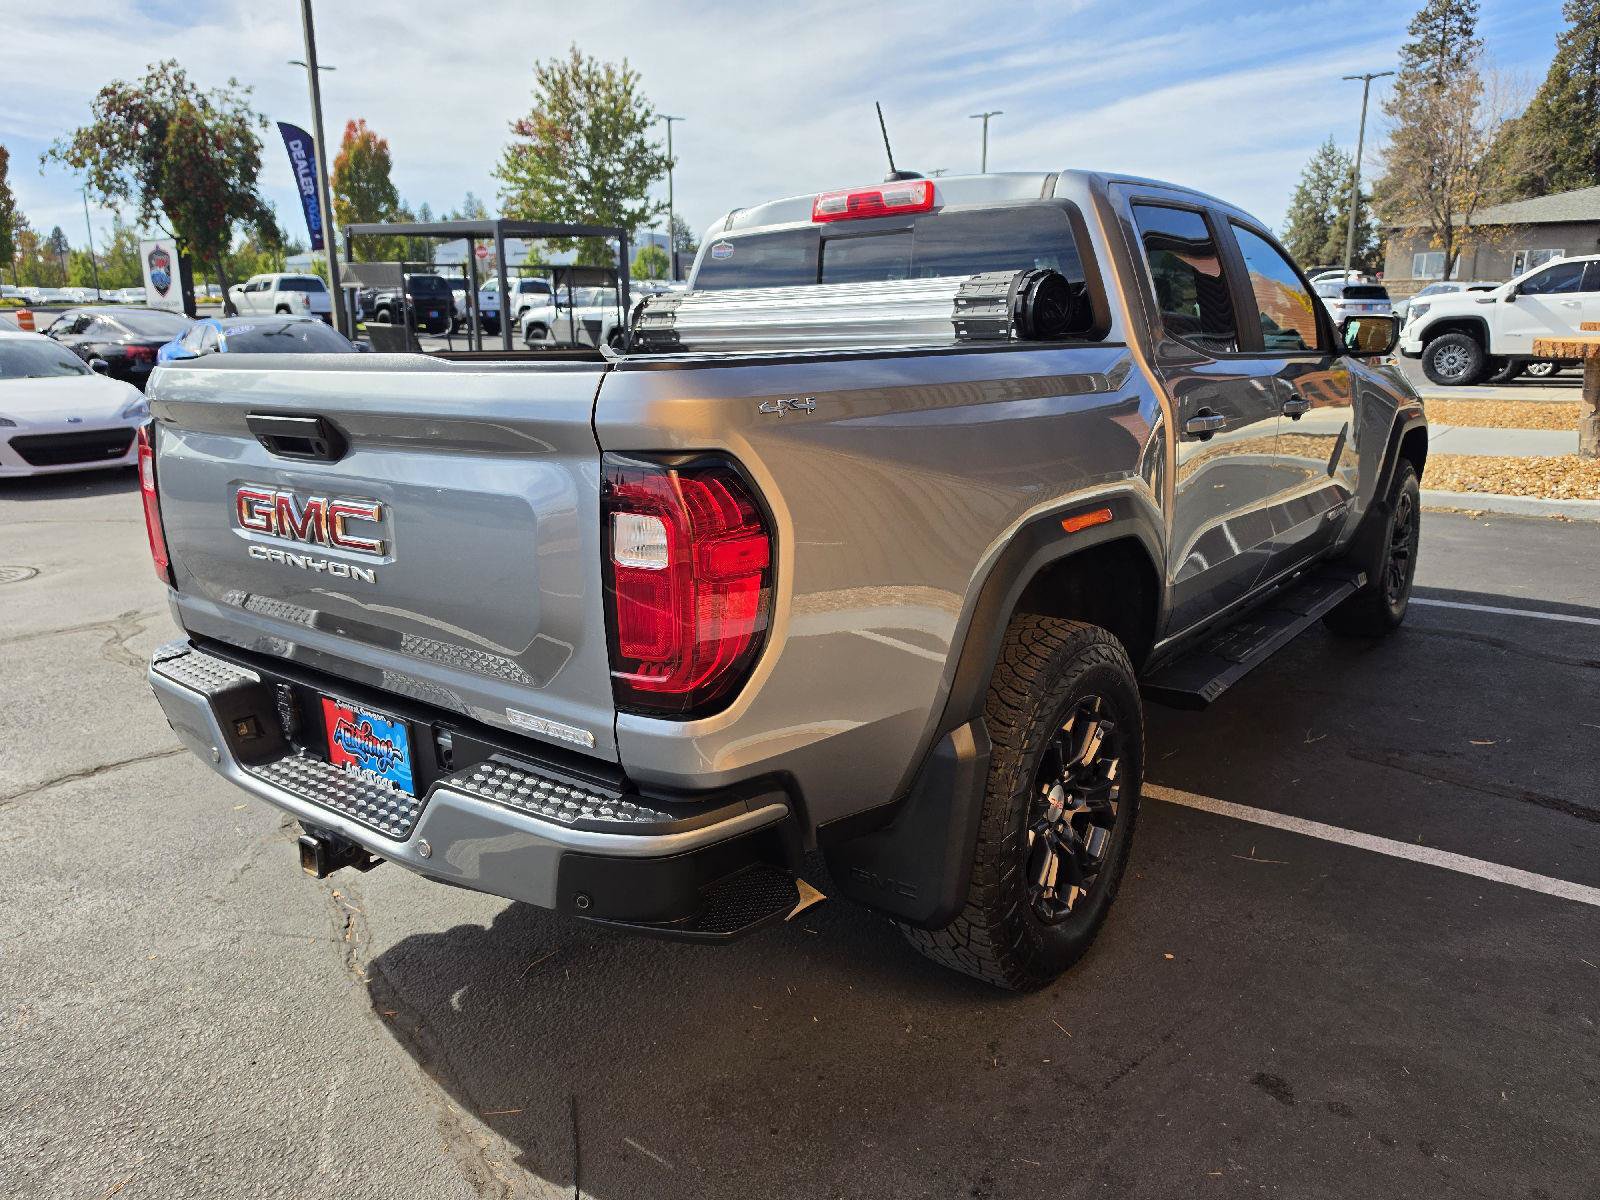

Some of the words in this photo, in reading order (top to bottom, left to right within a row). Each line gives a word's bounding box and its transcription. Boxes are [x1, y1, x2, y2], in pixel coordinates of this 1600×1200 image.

[289, 139, 315, 196] DEALER
[236, 486, 385, 557] GMC
[248, 545, 377, 584] CANYON
